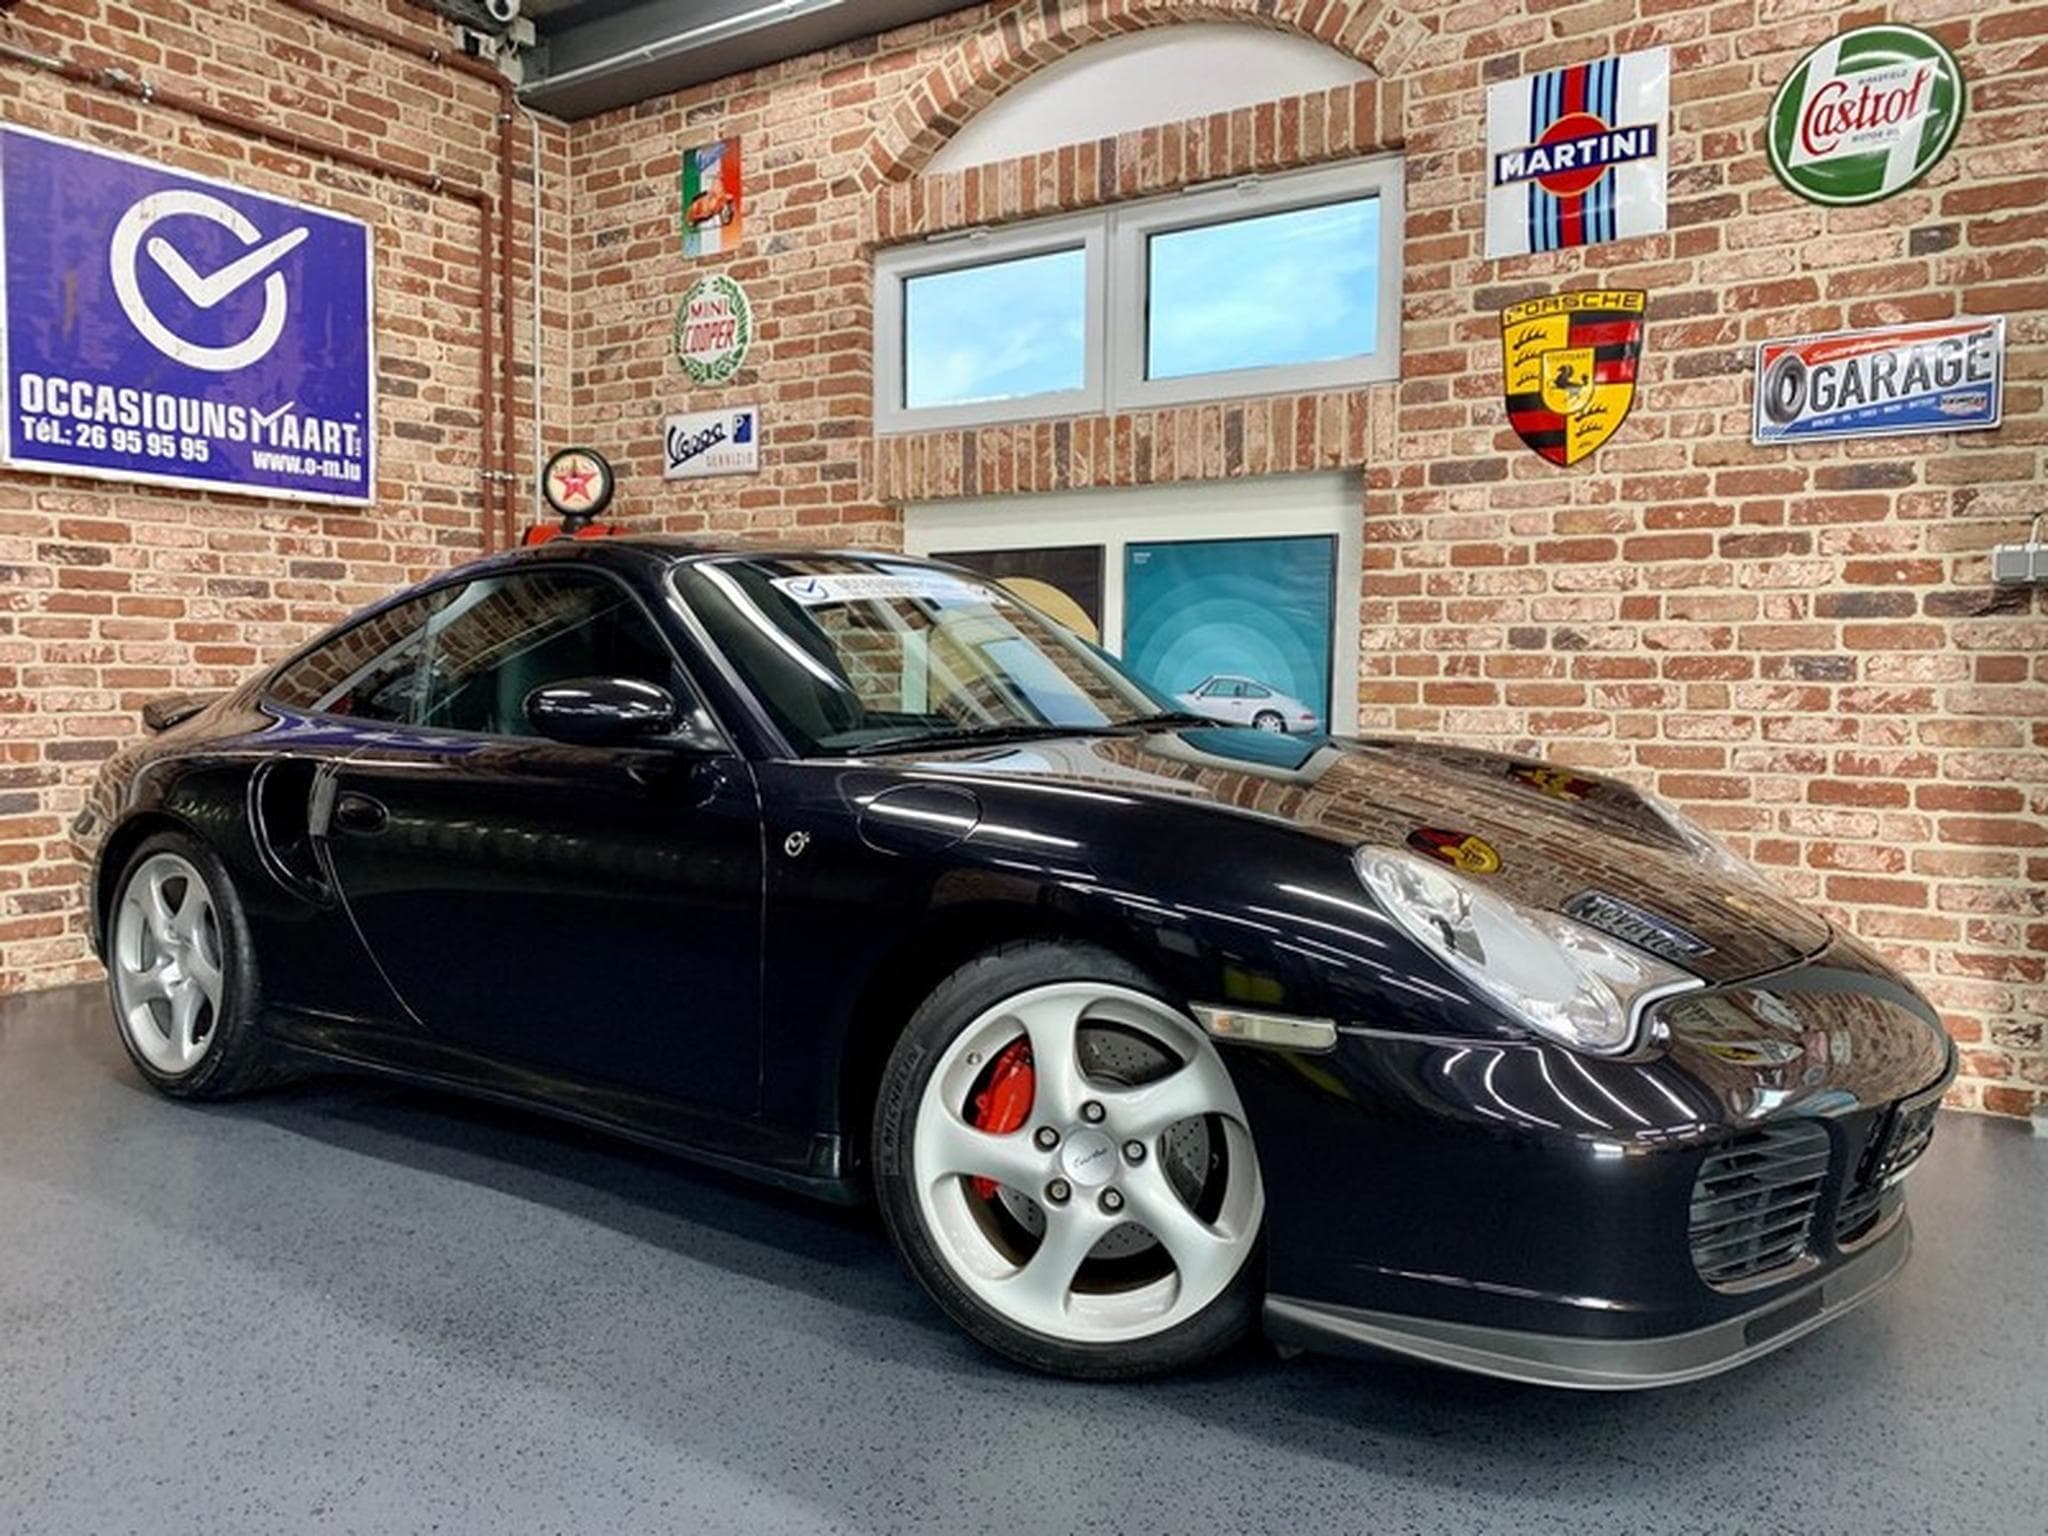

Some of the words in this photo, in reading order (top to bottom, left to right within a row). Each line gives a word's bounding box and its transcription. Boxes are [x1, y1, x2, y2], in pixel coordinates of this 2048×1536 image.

[1801, 66, 1929, 156] Castrol
[1501, 128, 1650, 182] MARTINI
[690, 299, 728, 318] MINI
[1507, 292, 1641, 322] PORSCHE
[683, 319, 736, 354] COOPER
[1809, 330, 1994, 413] GARAGE
[76, 423, 107, 450] 26
[111, 428, 143, 454] 95
[147, 432, 176, 459] 95
[180, 437, 209, 462] 95
[252, 450, 362, 482] www.o-m.lu
